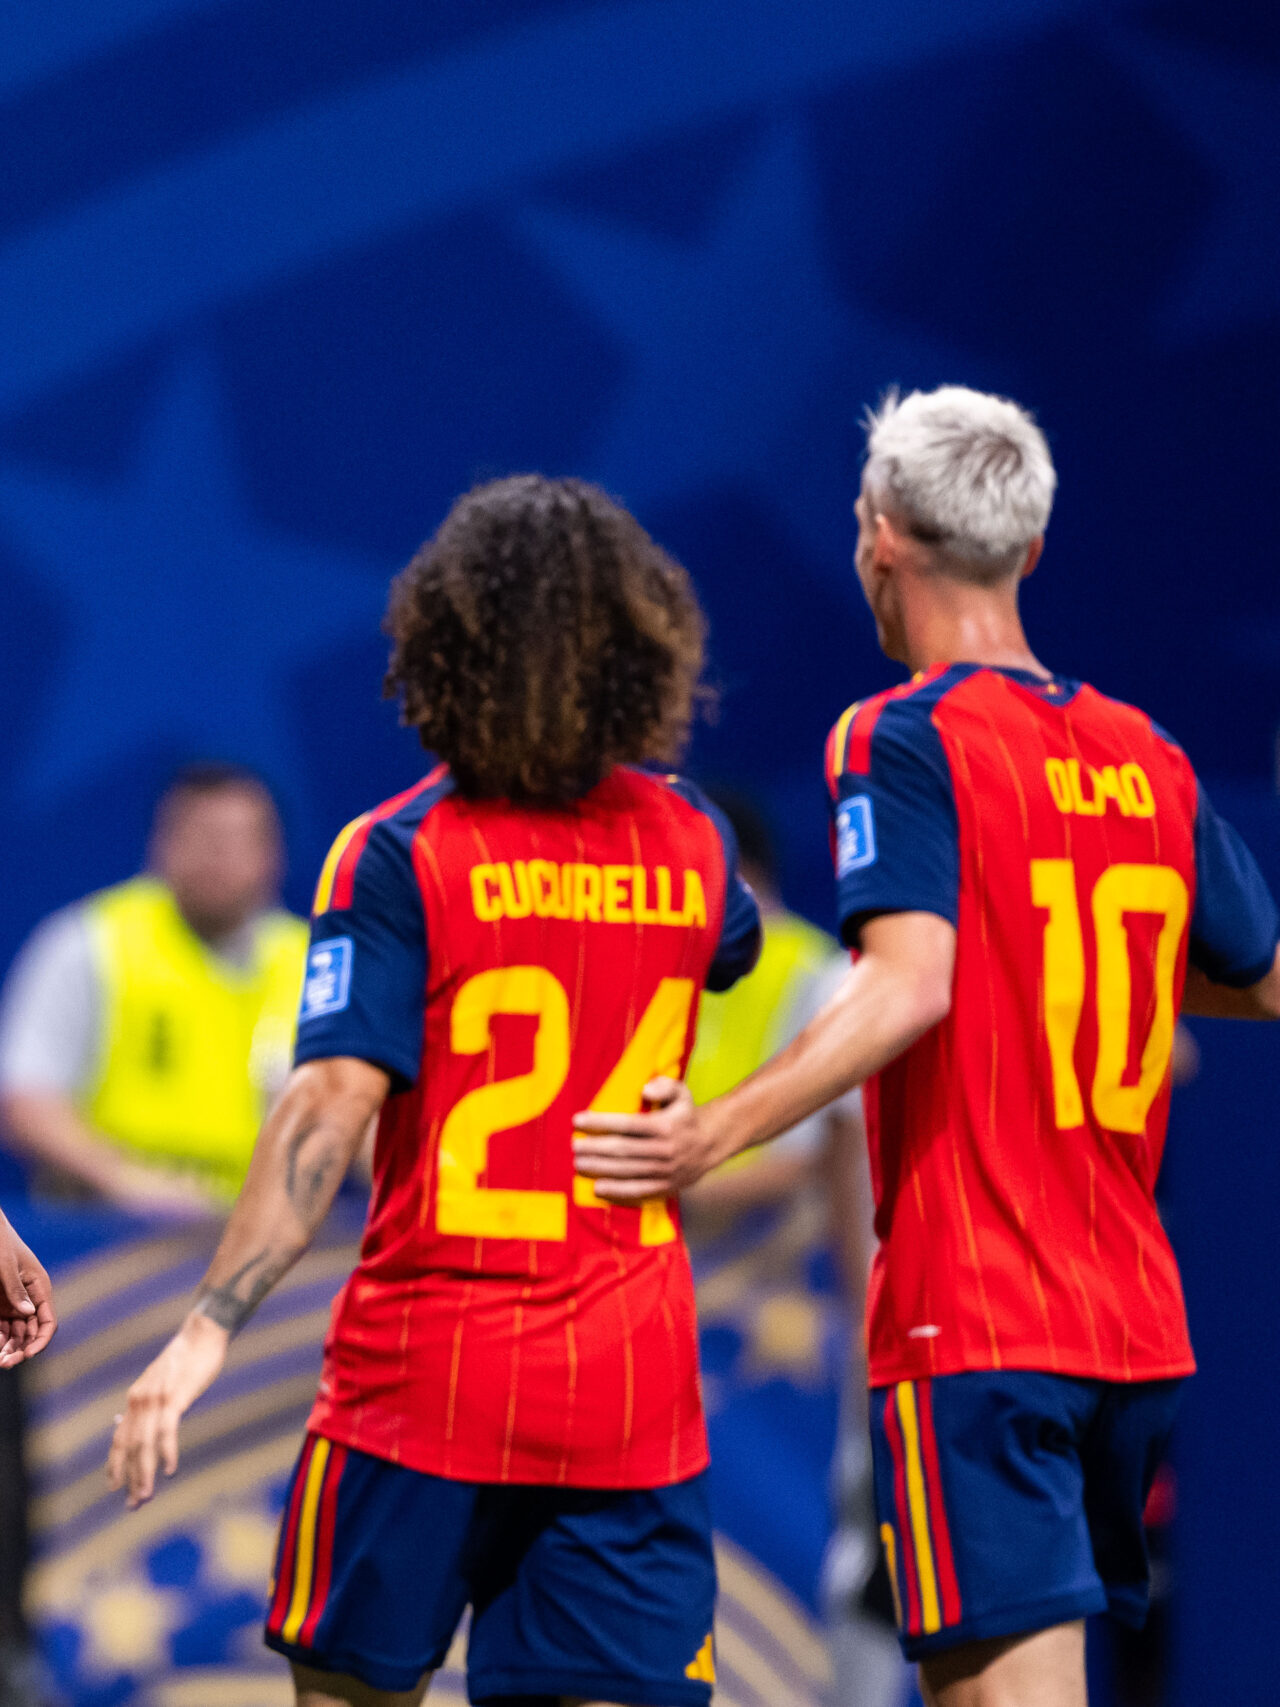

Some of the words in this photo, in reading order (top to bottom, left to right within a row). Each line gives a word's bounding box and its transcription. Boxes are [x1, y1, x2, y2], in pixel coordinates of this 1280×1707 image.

[1045, 757, 1156, 818] OLMO
[470, 858, 707, 928] CUCURELLA
[1030, 858, 1189, 1134] 10
[435, 965, 695, 1246] 24
